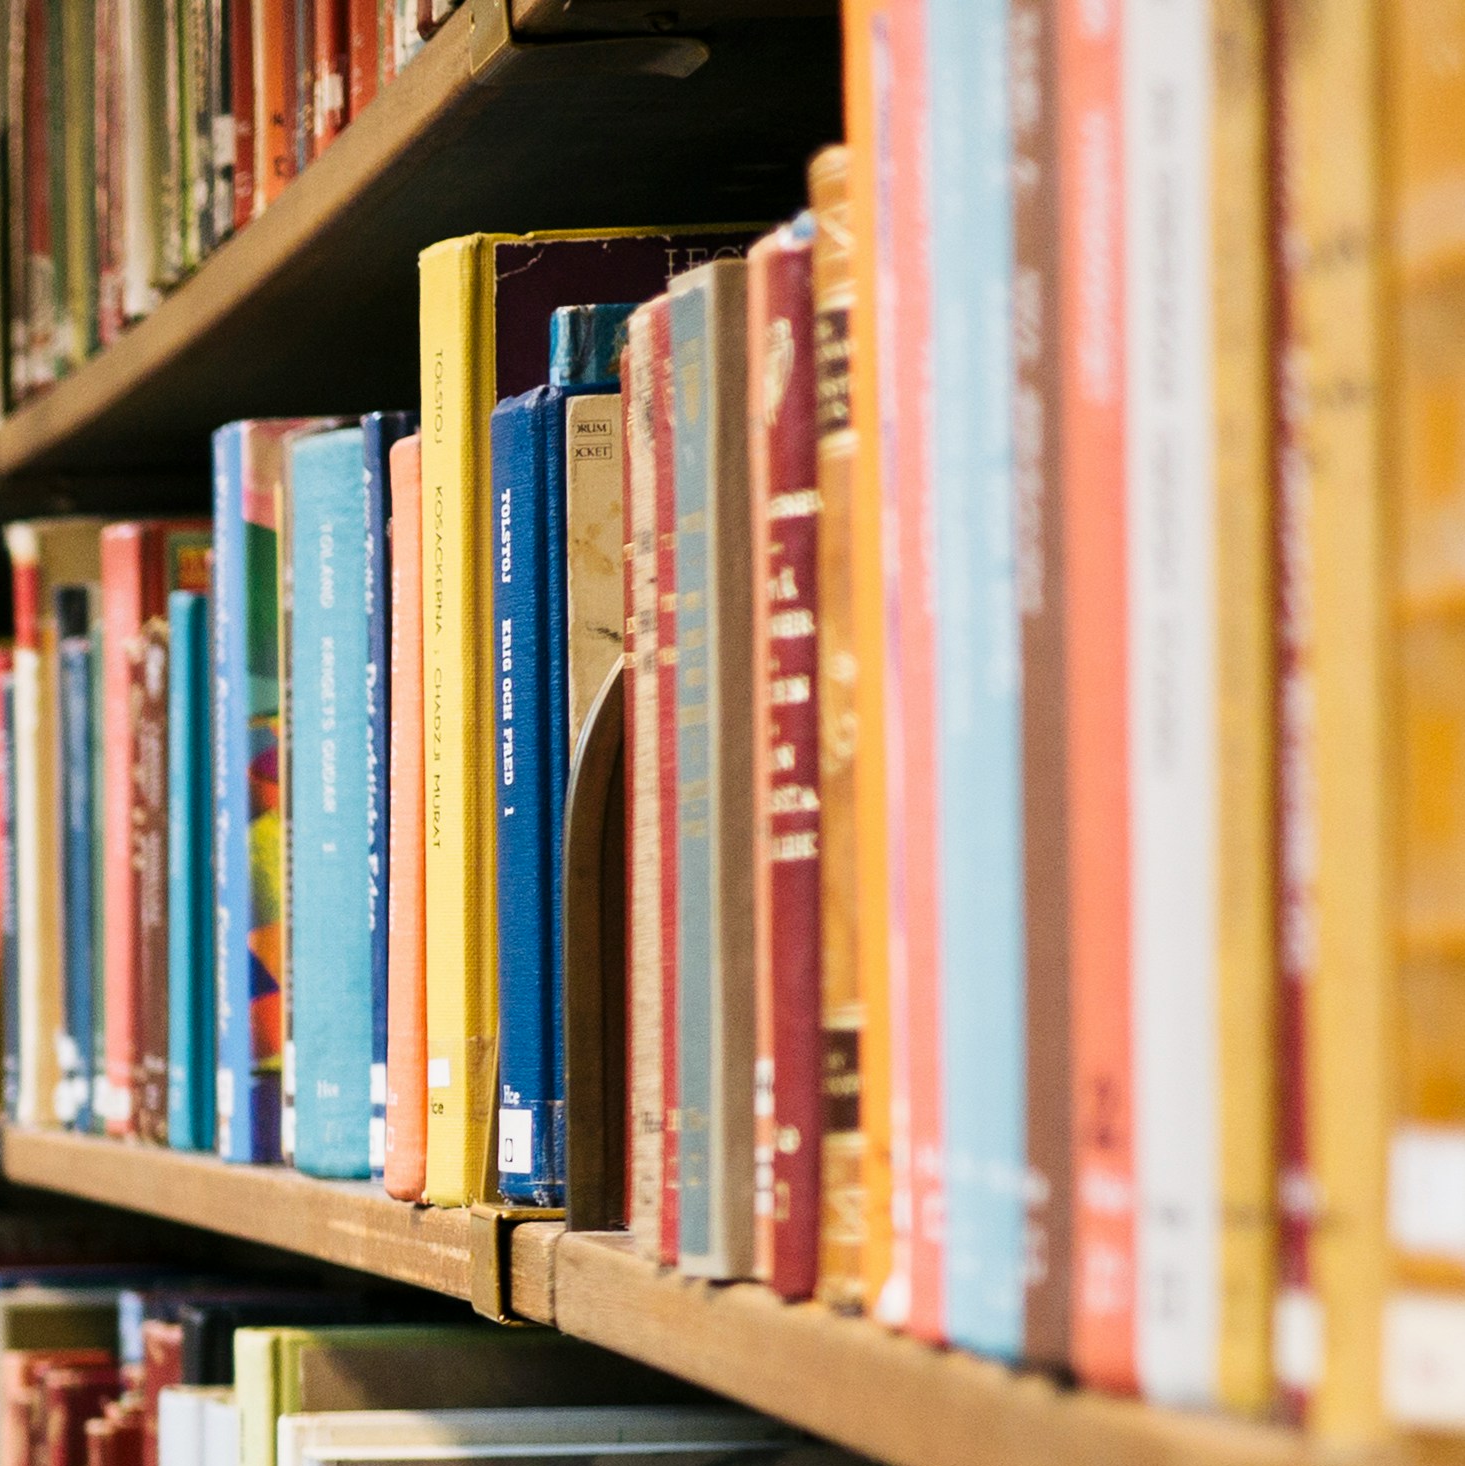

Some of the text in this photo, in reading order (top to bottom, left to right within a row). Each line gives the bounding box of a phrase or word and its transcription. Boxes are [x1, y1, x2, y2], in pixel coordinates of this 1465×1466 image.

[434, 349, 444, 445] TOLSTOJ
[433, 485, 444, 637] KOSACKERNA
[320, 636, 338, 732] KRIGETS
[500, 488, 515, 817] TOLSTOJ KRIG OCH FRED 1
[432, 774, 442, 850] MURAT
